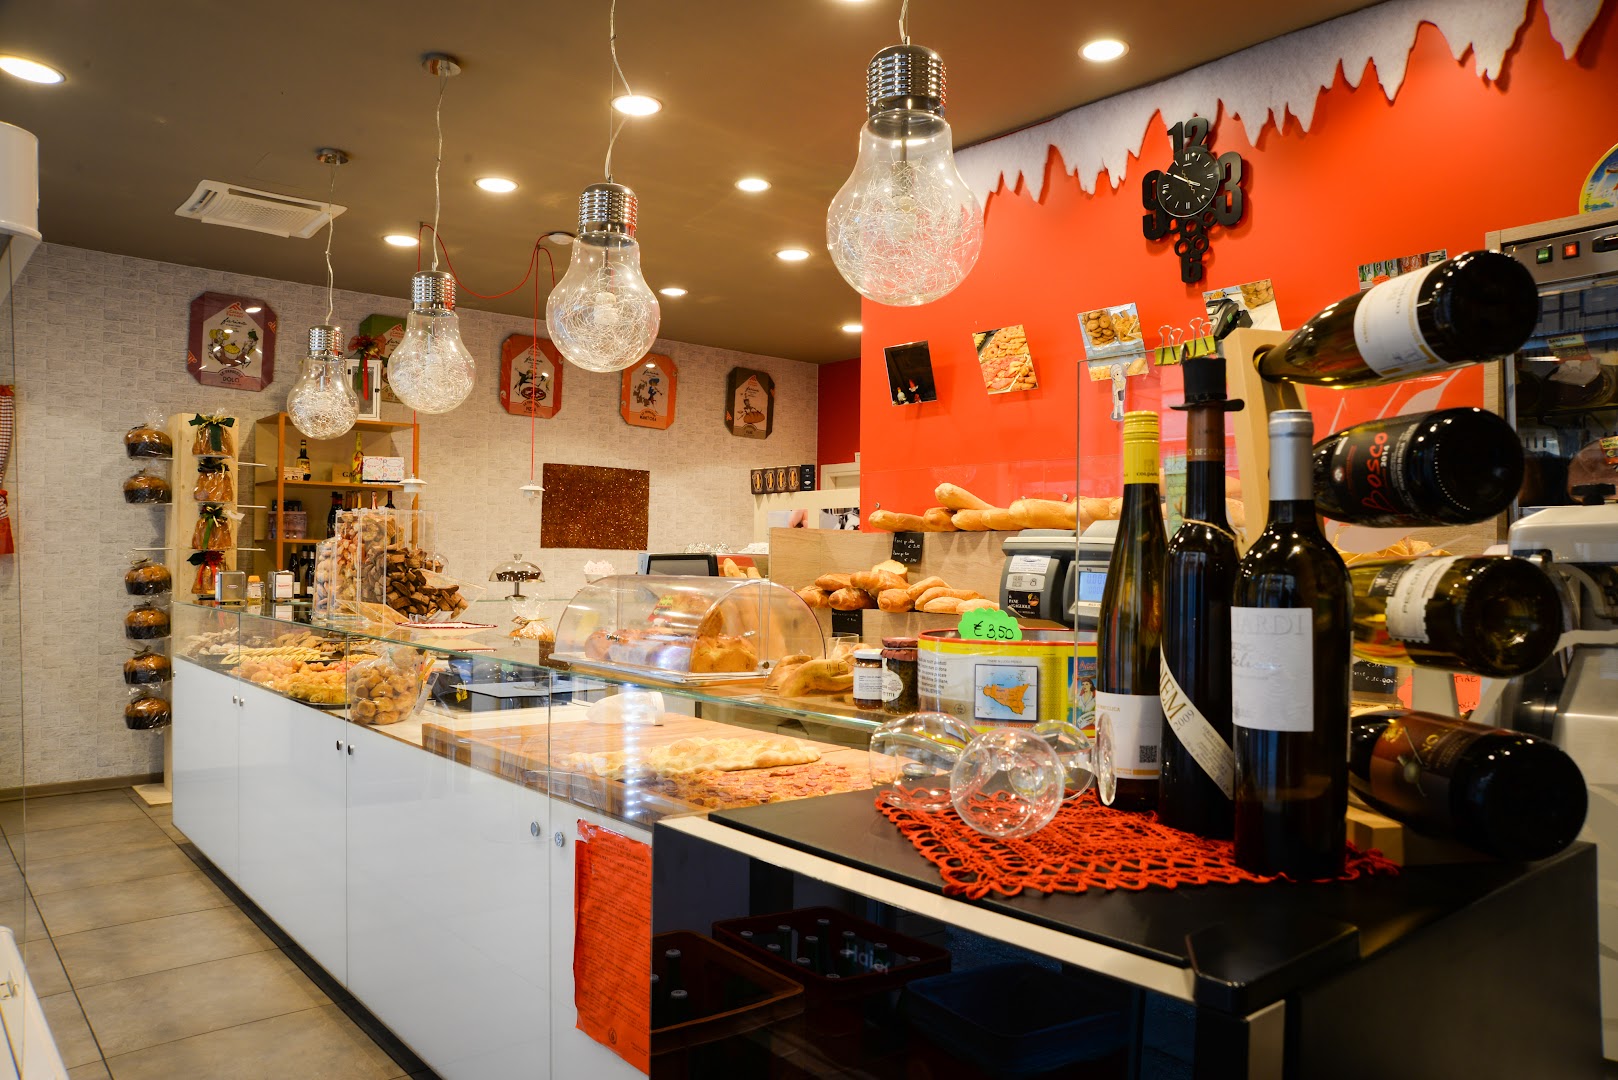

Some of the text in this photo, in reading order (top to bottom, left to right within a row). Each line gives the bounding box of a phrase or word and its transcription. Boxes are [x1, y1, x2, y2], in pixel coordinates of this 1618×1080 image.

[1167, 117, 1209, 160] 12
[1142, 169, 1168, 241] 9
[1216, 151, 1242, 226] 3
[1380, 444, 1391, 467] 2014
[973, 620, 1014, 641] € 3,50
[1173, 709, 1195, 731] 2009
